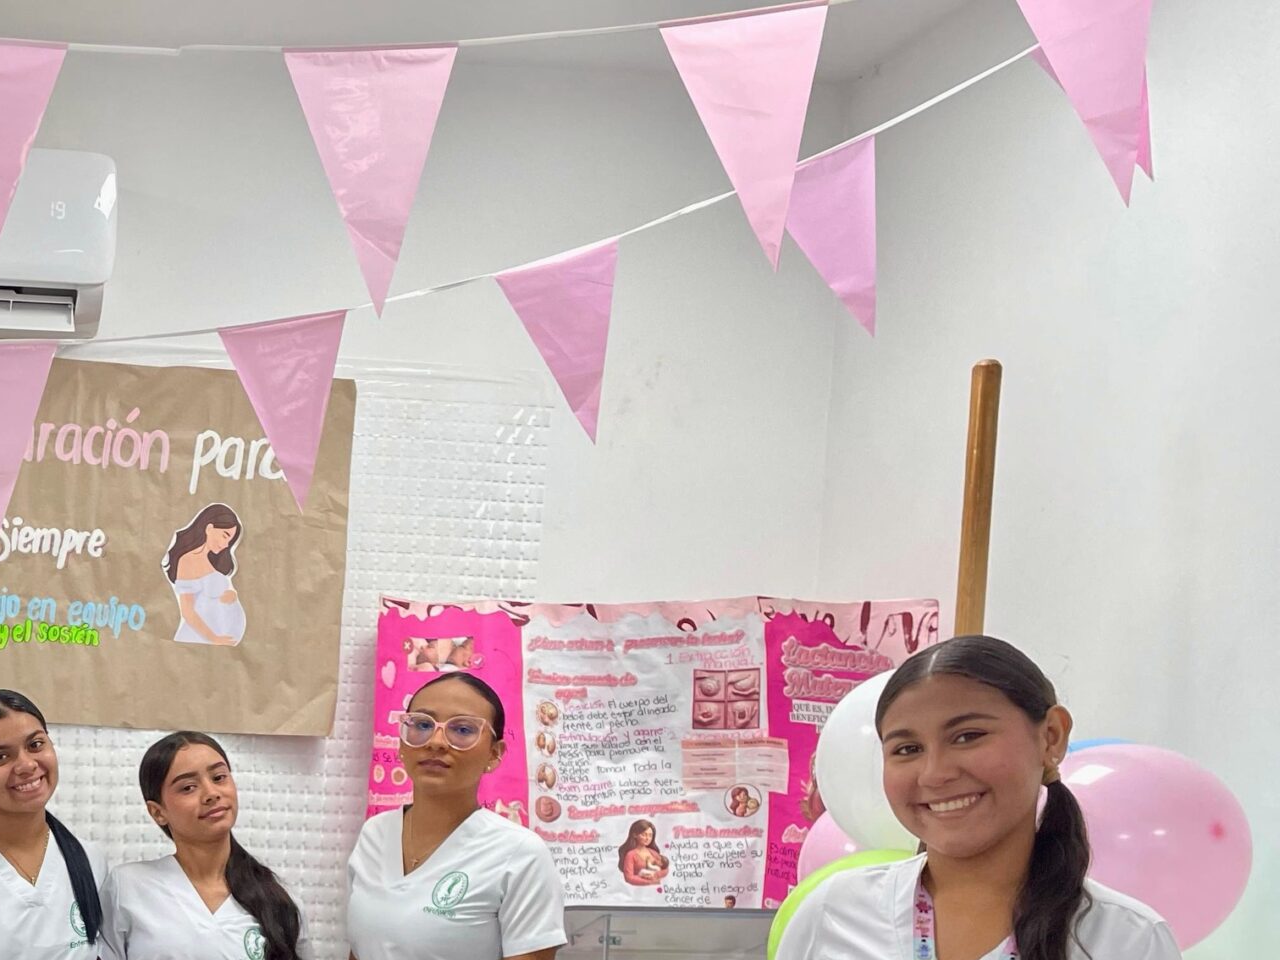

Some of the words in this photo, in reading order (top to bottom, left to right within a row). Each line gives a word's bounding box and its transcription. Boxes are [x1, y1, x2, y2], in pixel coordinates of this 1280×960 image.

[50, 200, 66, 220] 19
[27, 596, 56, 624] en
[68, 596, 147, 639] equipo
[11, 618, 32, 642] el
[670, 839, 699, 854] Ayuda
